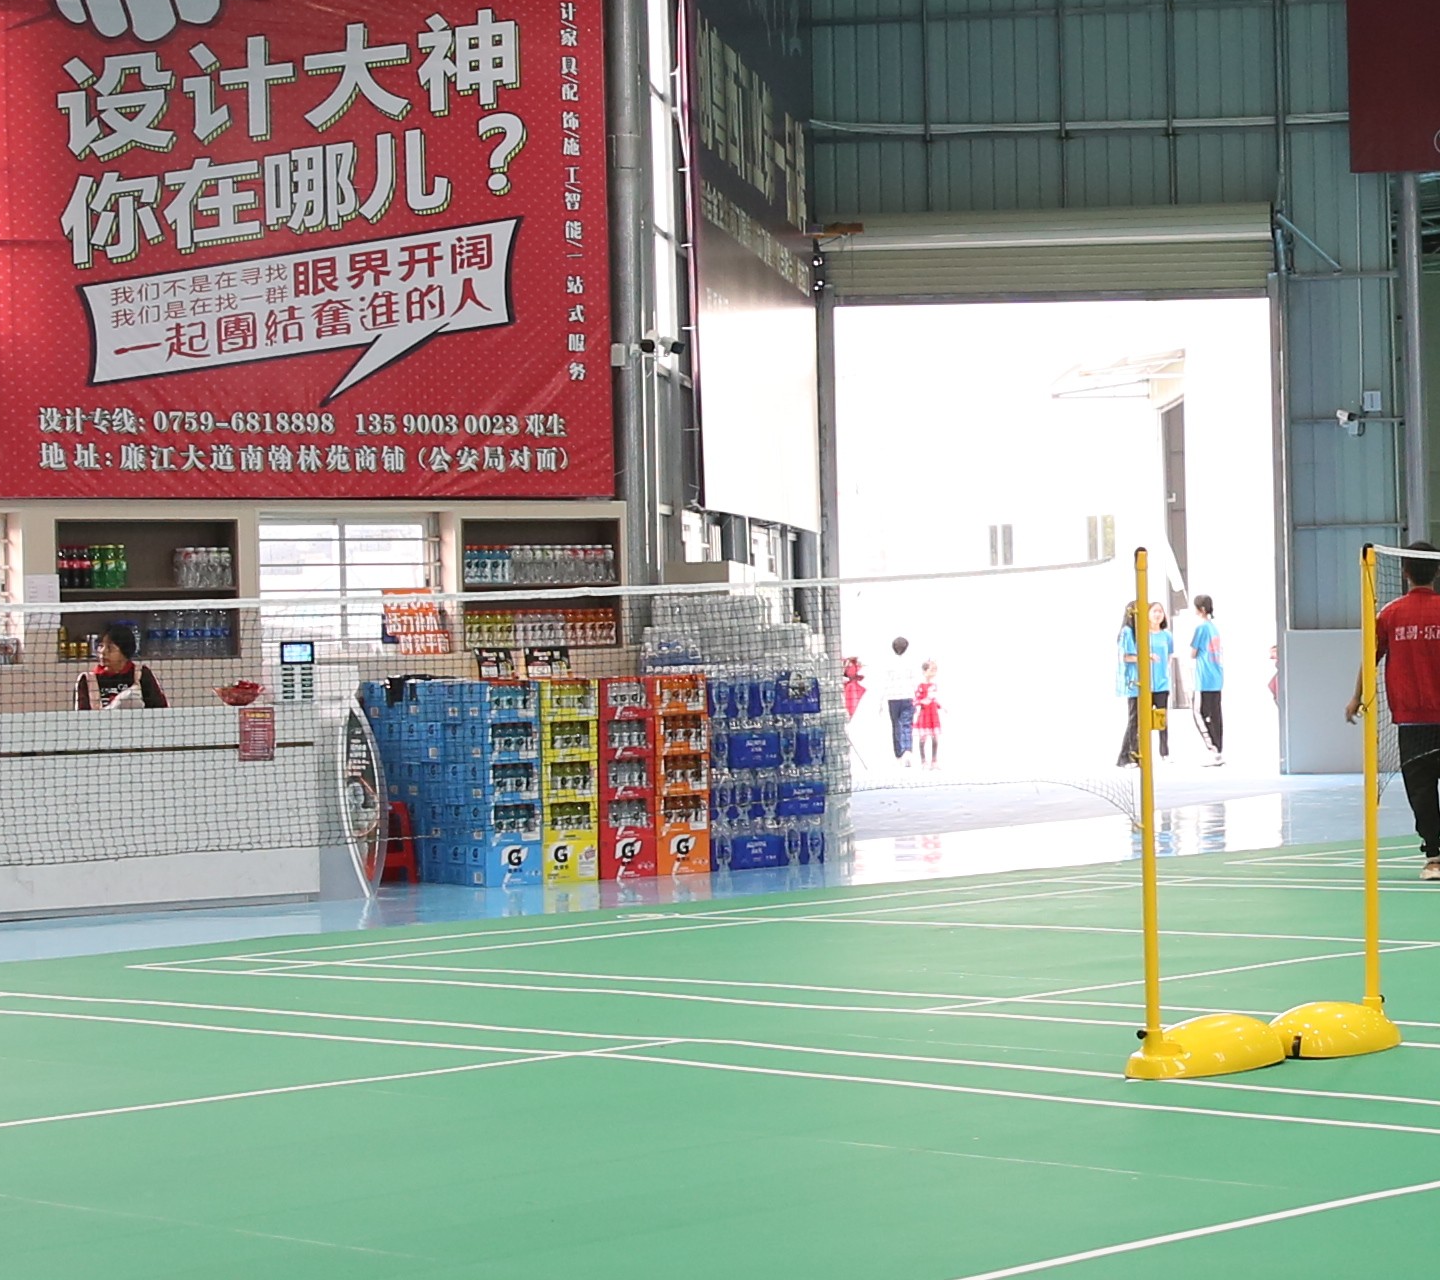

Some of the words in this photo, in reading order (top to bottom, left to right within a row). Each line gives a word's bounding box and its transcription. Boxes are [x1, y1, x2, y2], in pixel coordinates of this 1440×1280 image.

[57, 9, 521, 161] 设计大神
[293, 235, 494, 299] 眼界开阔
[110, 264, 288, 307] 我们不是在寻找
[110, 286, 289, 329] 我们是在找一群
[153, 409, 335, 435] 0759-6818898
[355, 412, 398, 435] 135
[402, 412, 459, 436] 9003
[464, 412, 520, 437] 0023
[526, 412, 567, 439] 邓生
[508, 848, 522, 866] G
[554, 845, 568, 863] G
[622, 842, 635, 859] G
[677, 838, 690, 855] G
